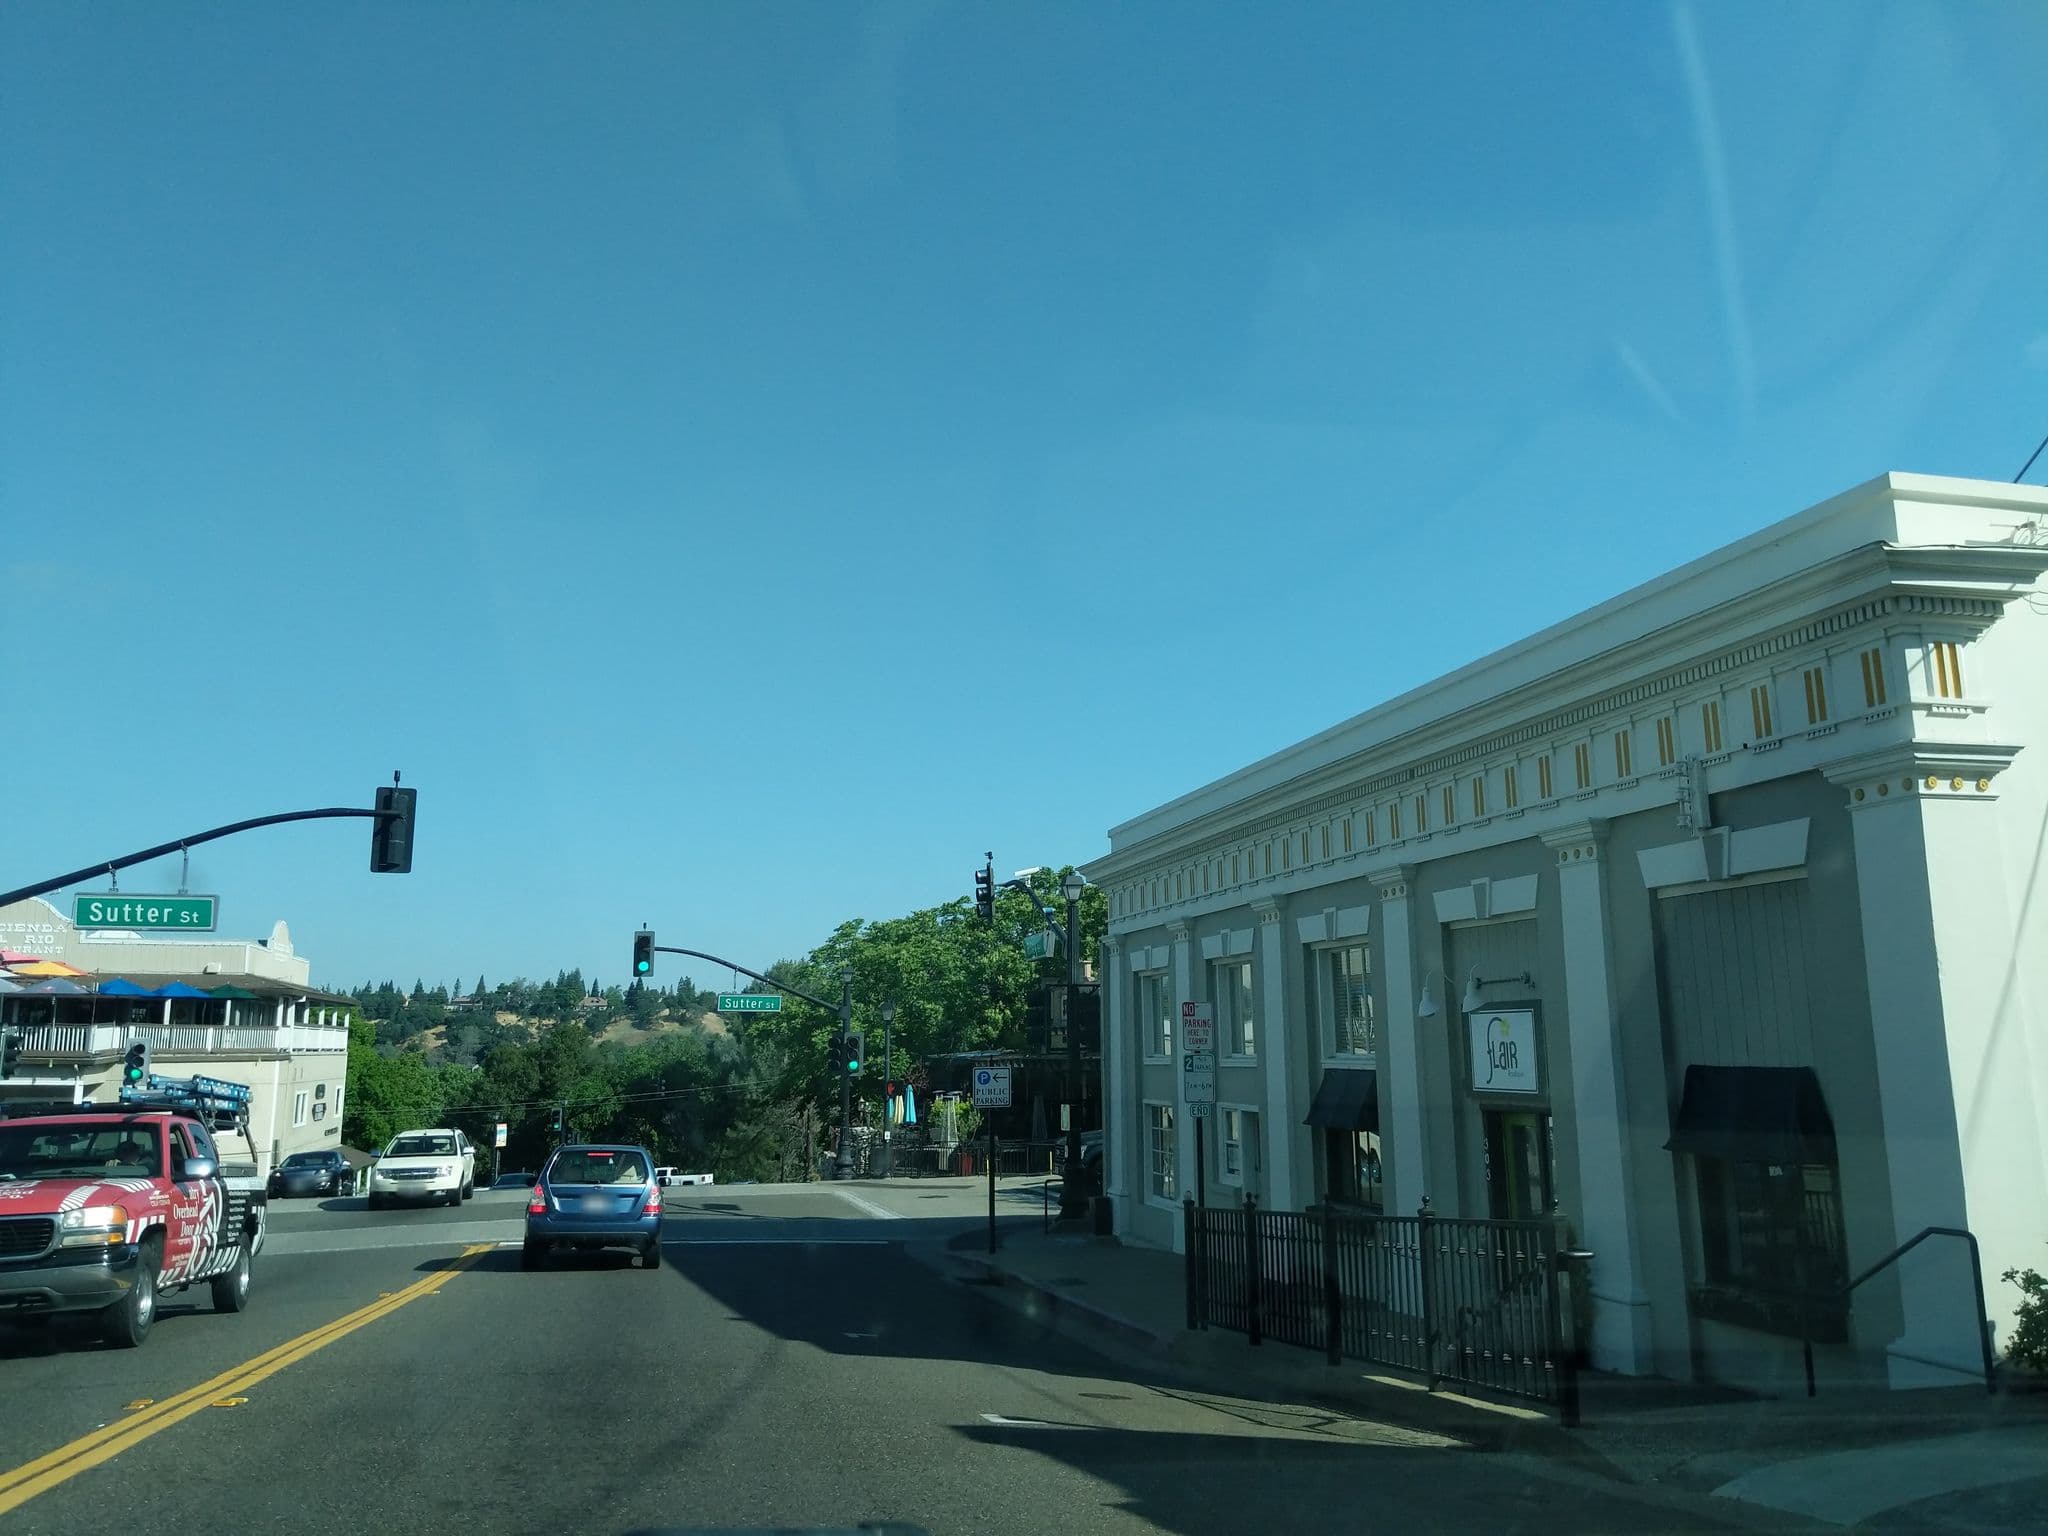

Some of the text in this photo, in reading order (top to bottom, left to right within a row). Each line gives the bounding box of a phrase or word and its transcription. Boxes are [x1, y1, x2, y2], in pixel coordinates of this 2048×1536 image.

[89, 902, 199, 923] Sutter St
[24, 935, 54, 944] RIO
[725, 998, 763, 1009] Sutter
[1183, 1003, 1194, 1016] NO
[1184, 1018, 1212, 1029] PARKING
[1185, 1057, 1193, 1070] 2
[976, 1096, 1008, 1104] PARKING
[1191, 1106, 1209, 1116] END
[173, 1201, 199, 1220] Overhead
[180, 1221, 195, 1238] Door
